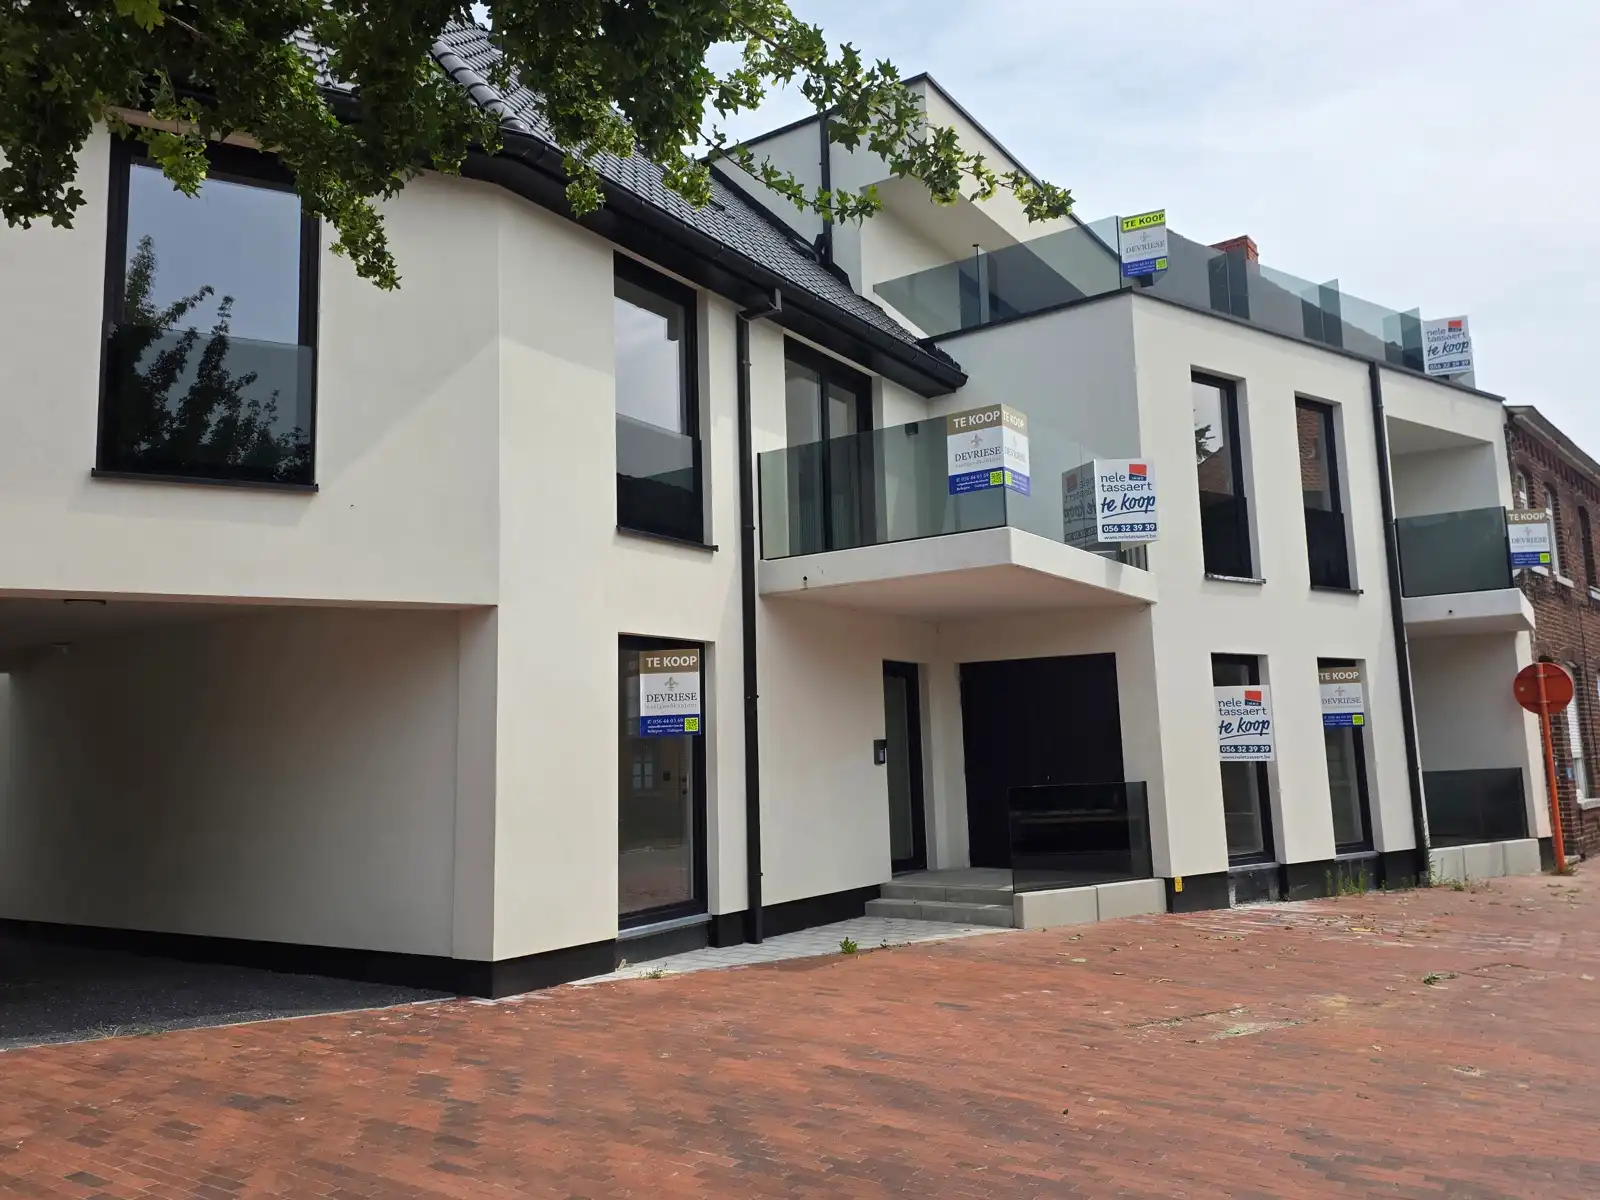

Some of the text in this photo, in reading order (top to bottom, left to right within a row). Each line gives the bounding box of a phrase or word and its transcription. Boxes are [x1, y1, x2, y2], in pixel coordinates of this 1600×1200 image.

[1124, 213, 1164, 228] TE KOOP
[1126, 240, 1165, 254] DEVRIESE
[1427, 328, 1446, 336] nele
[1427, 341, 1469, 357] te koop
[953, 410, 1000, 428] TE KOOP
[1002, 411, 1025, 428] TE KOOP
[955, 446, 1001, 462] DEVRIESE
[1100, 472, 1126, 483] nele
[1101, 482, 1152, 492] tassaert
[1100, 493, 1155, 514] te koop
[1508, 512, 1546, 521] TE KOOP
[1120, 524, 1131, 532] 32
[1145, 523, 1155, 531] 39
[646, 655, 698, 668] TE KOOP
[1319, 671, 1359, 680] TE KOOP
[646, 692, 697, 703] DEVRIESE
[1218, 697, 1242, 707] nele
[1322, 696, 1361, 705] DEVRIESE
[1218, 706, 1267, 716] tassaert
[1218, 717, 1270, 736] te koop
